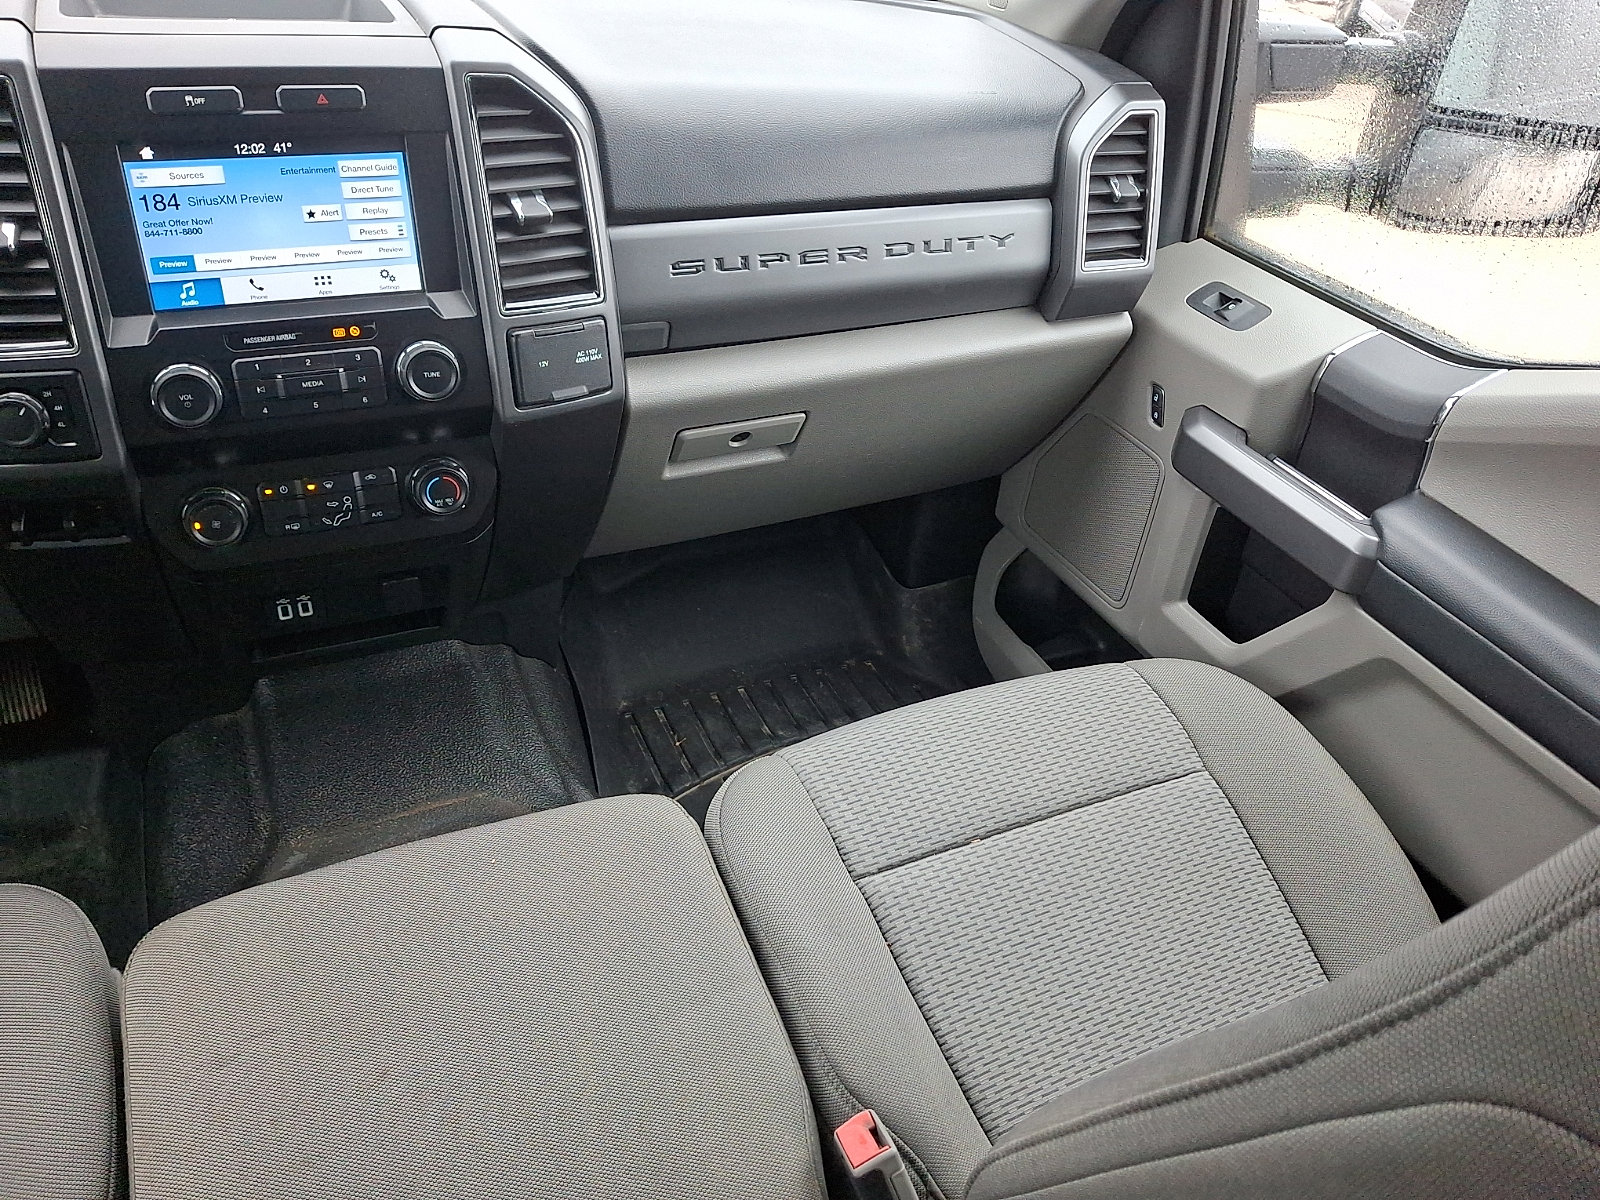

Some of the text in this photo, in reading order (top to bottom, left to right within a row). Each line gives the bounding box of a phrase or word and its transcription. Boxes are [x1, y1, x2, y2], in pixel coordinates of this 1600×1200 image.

[194, 97, 206, 105] OFF
[234, 142, 266, 155] 12:02
[280, 166, 336, 176] Entertainment
[341, 164, 397, 173] Channel Guide
[169, 171, 205, 181] Sources
[350, 185, 394, 194] Direct Tune
[139, 193, 181, 212] 184
[187, 193, 283, 207] SiriusXM Preview
[320, 209, 340, 217] Alert
[362, 206, 389, 216] Replay
[142, 217, 213, 228] Great Offer Now!
[359, 228, 388, 236] Presets
[669, 232, 1015, 277] SUPER DUTY
[159, 260, 188, 268] Preview
[181, 299, 199, 307] Audio
[243, 333, 297, 345] PASSENGER AIRBAG
[354, 353, 361, 361] 3
[577, 350, 586, 358] AC
[590, 353, 603, 361] MAX
[305, 358, 312, 366] 2
[538, 360, 549, 368] 12V
[423, 370, 441, 379] TUNE
[301, 379, 325, 389] MEDIA
[179, 392, 194, 402] VOL
[371, 510, 384, 518] A/C
